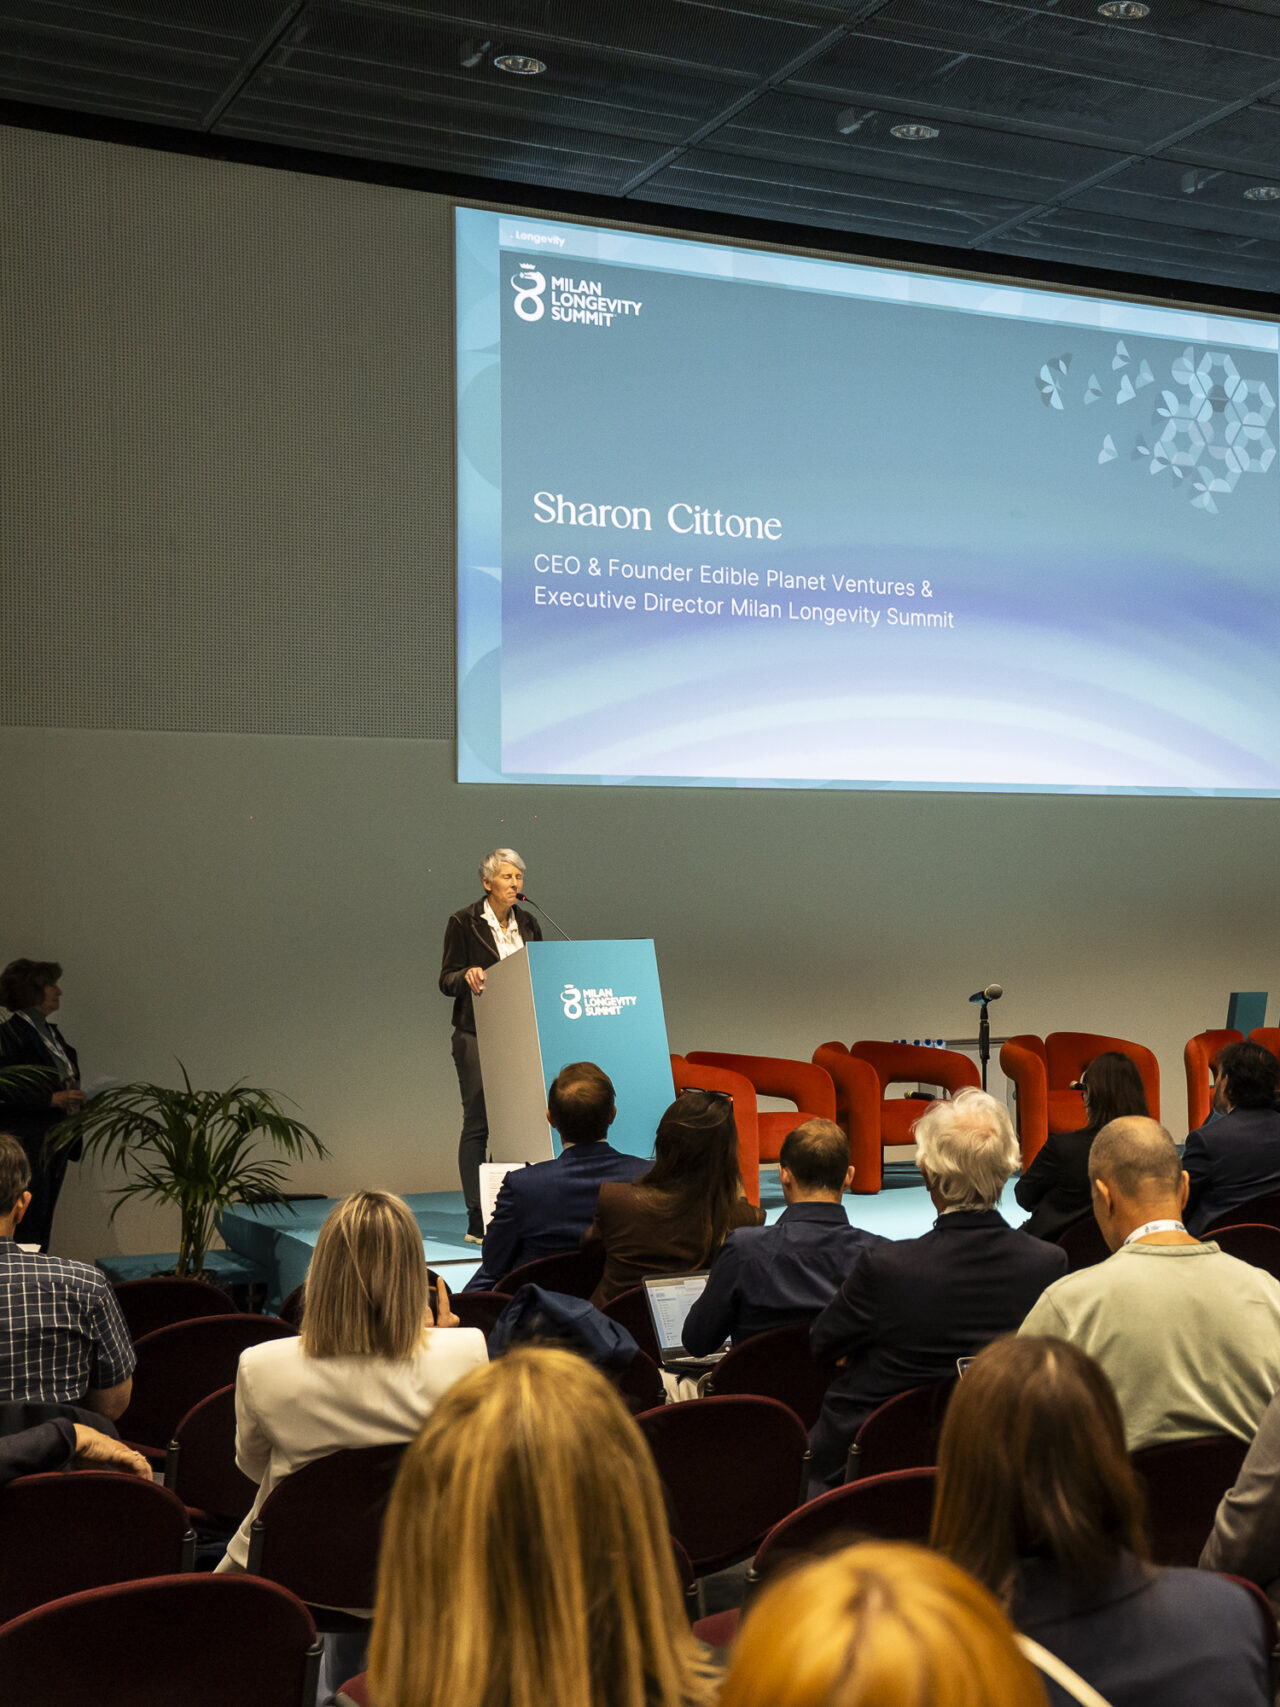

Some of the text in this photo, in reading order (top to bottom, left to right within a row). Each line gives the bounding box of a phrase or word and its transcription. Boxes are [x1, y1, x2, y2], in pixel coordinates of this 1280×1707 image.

[515, 230, 565, 247] Longevity
[551, 276, 602, 296] MILAN
[551, 291, 643, 316] LONGEVITY
[551, 306, 613, 327] SUMMIT
[533, 491, 783, 540] Sharon Cittone
[534, 553, 933, 598] CEO & Founder Edible Planet Ventures &
[535, 586, 955, 629] Executive Director Milan Longevity Summit
[583, 988, 613, 998] MILAN
[584, 996, 637, 1007] LONGEVITY
[585, 1006, 623, 1016] SUMMIT
